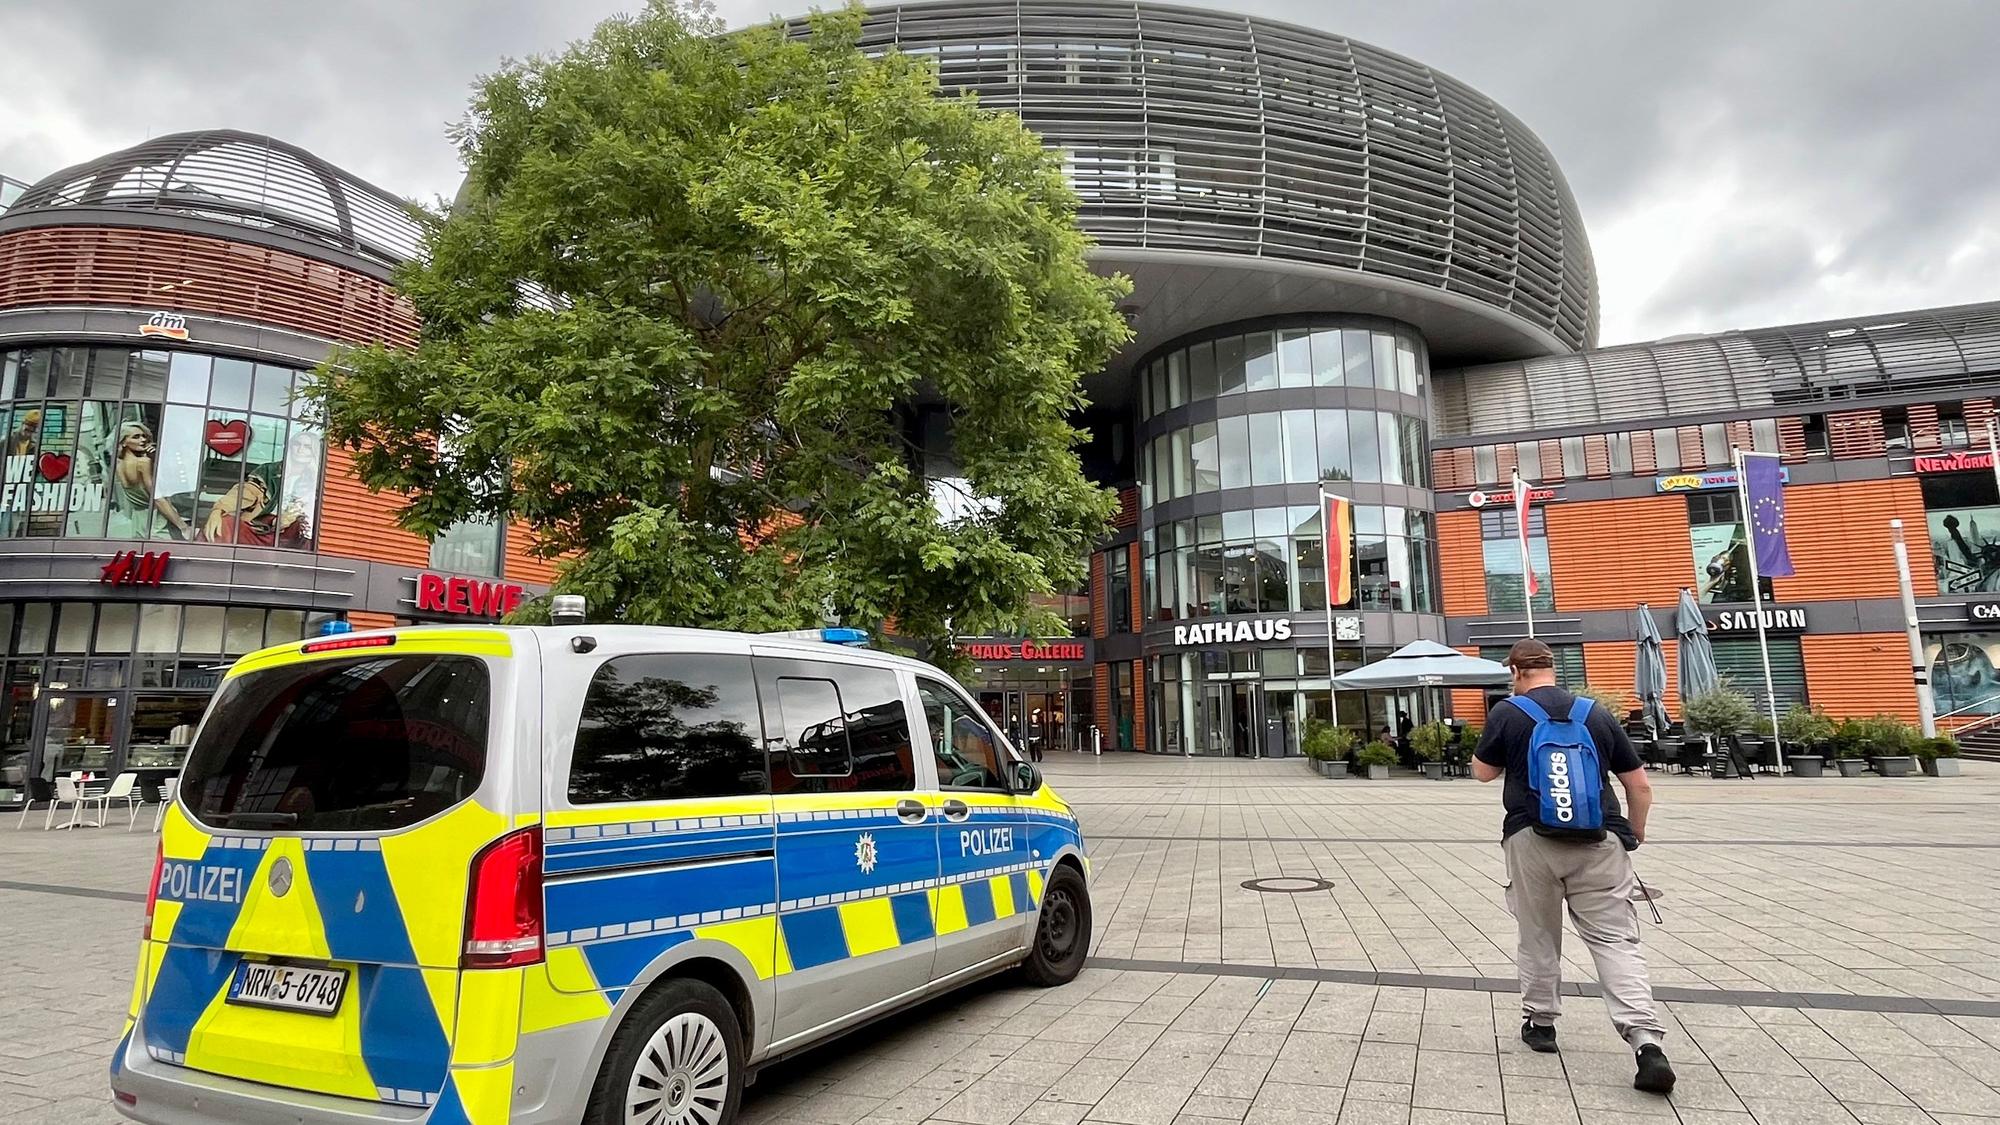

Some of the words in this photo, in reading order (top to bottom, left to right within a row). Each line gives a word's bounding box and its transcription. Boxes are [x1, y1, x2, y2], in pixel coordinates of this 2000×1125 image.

[150, 312, 184, 329] dm
[6, 455, 35, 483] WE
[1, 482, 103, 511] FASHION
[416, 572, 523, 616] REWE
[1174, 618, 1292, 646] RATHAUS
[1719, 609, 1806, 630] SATURN
[1021, 640, 1084, 660] GALERIE
[1548, 752, 1573, 822] adidas
[960, 827, 1013, 858] POLIZEI
[158, 862, 243, 904] POLIZEI
[240, 967, 276, 998] NRW
[278, 971, 341, 1006] 5-6748
